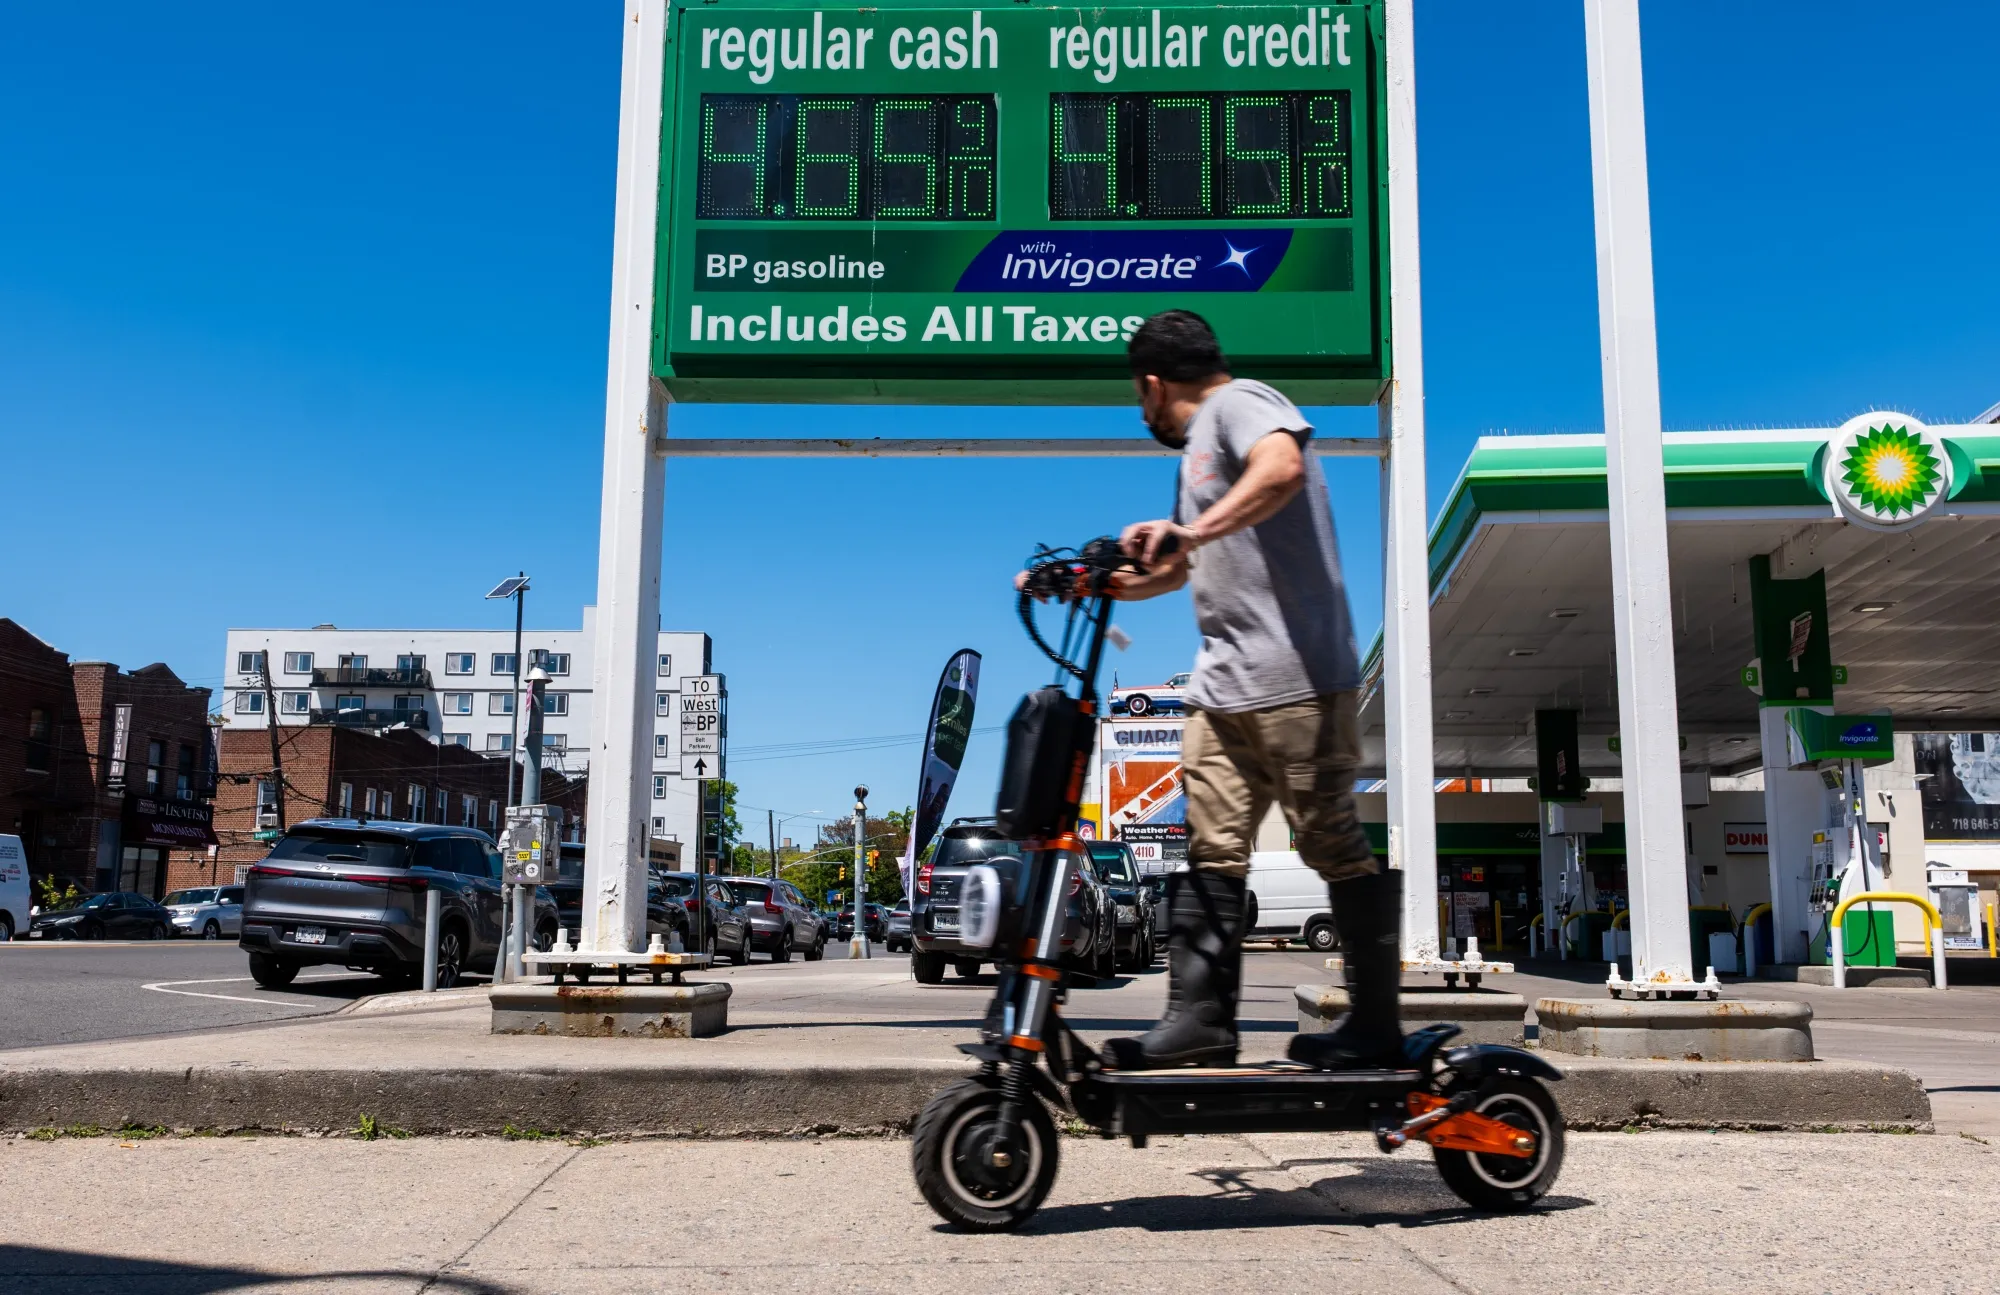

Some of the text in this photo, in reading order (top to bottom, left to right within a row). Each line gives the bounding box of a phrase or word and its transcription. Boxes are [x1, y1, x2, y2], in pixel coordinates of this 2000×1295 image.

[701, 10, 999, 85] regular cash
[1050, 7, 1351, 84] regular credit
[704, 101, 936, 216] 4.65
[1054, 97, 1290, 214] 4.75
[1020, 241, 1056, 254] with
[706, 253, 885, 284] BP gasoline
[690, 305, 1146, 343] Includes All Taxes
[1745, 670, 1753, 682] 6
[1835, 668, 1843, 680] 5
[691, 680, 710, 693] TO
[683, 698, 717, 711] West
[697, 715, 717, 731] BP
[940, 715, 968, 737] smiles
[1116, 729, 1181, 746] GUARA
[1839, 735, 1879, 744] Invigorate
[688, 743, 712, 751] Parkway
[165, 803, 209, 821] LISOVETSKY
[151, 822, 207, 838] MONUMENTS
[1124, 826, 1187, 834] WeatherTec
[1952, 817, 2000, 831] 718 646-5
[1516, 828, 1541, 840] sho
[1726, 832, 1768, 846] DUN
[1134, 845, 1155, 858] 4110
